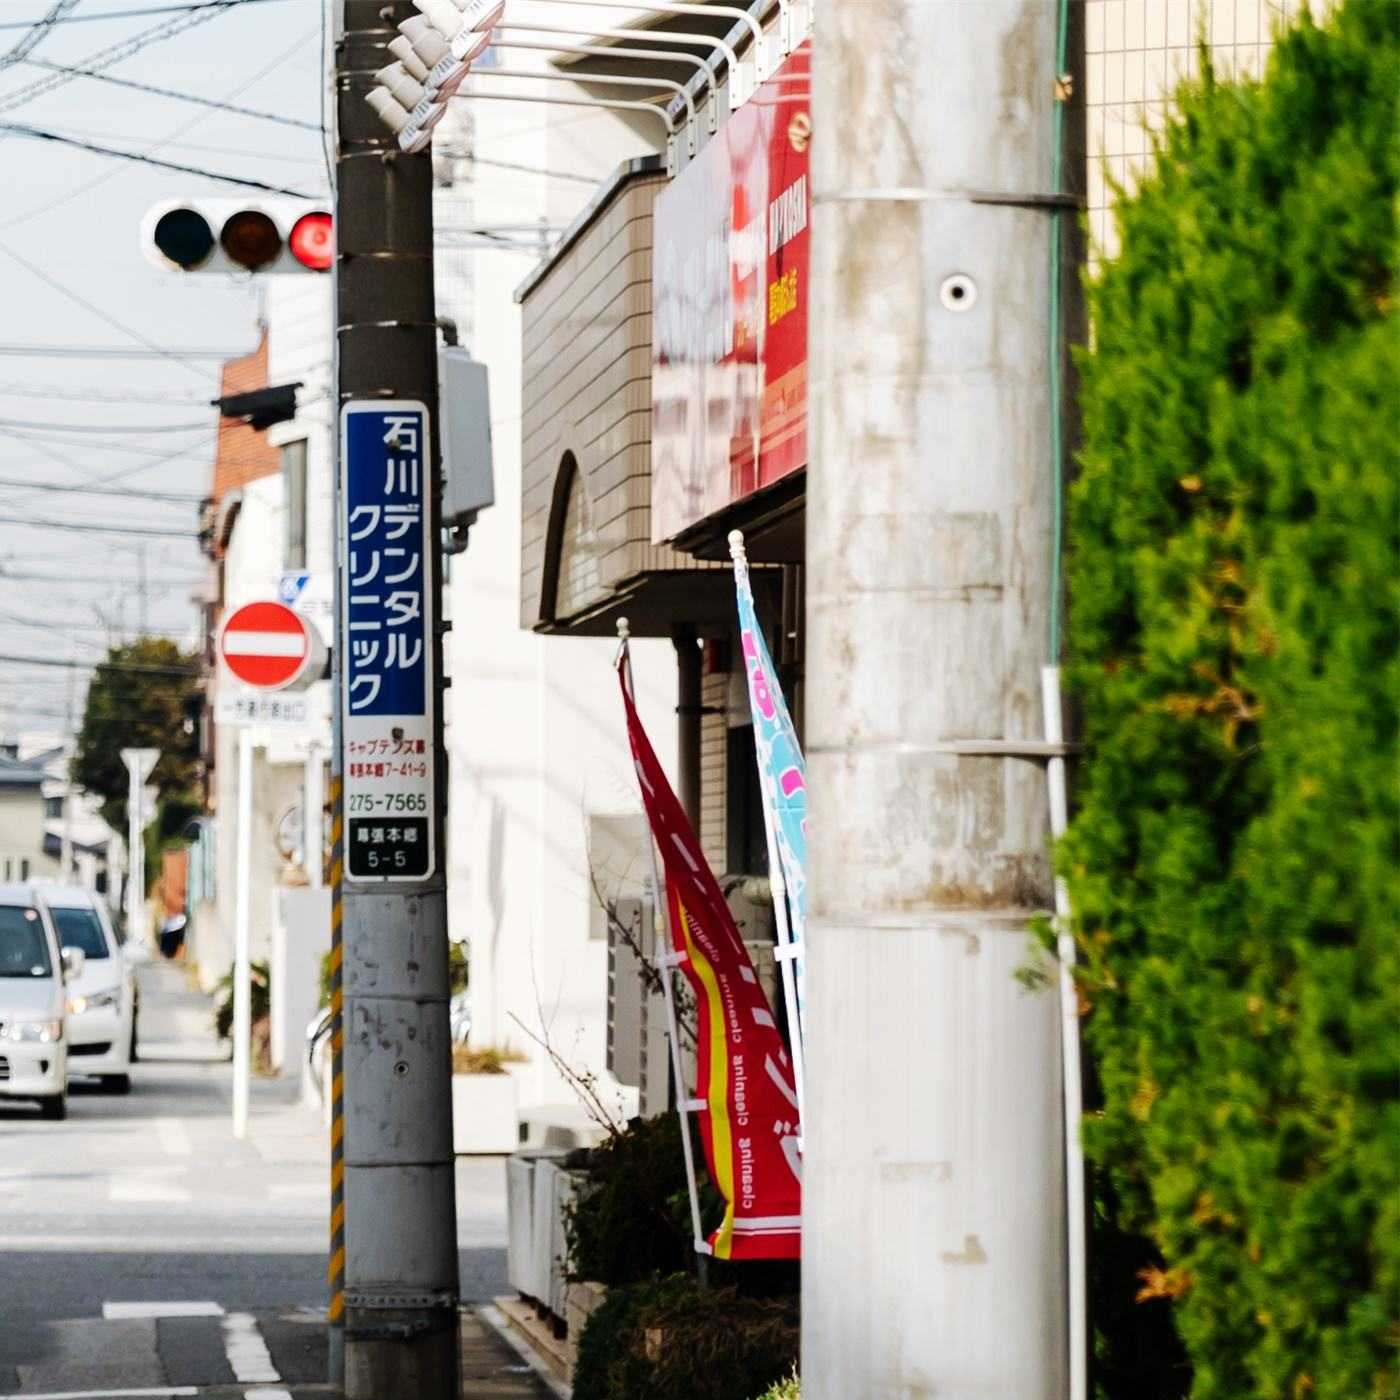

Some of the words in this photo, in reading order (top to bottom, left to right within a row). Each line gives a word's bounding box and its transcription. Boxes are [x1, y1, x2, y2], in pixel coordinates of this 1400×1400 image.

[383, 415, 422, 669] 石川デンタル
[350, 504, 382, 710] クリニック
[350, 793, 426, 812] 275-7565
[368, 850, 407, 867] 5-5
